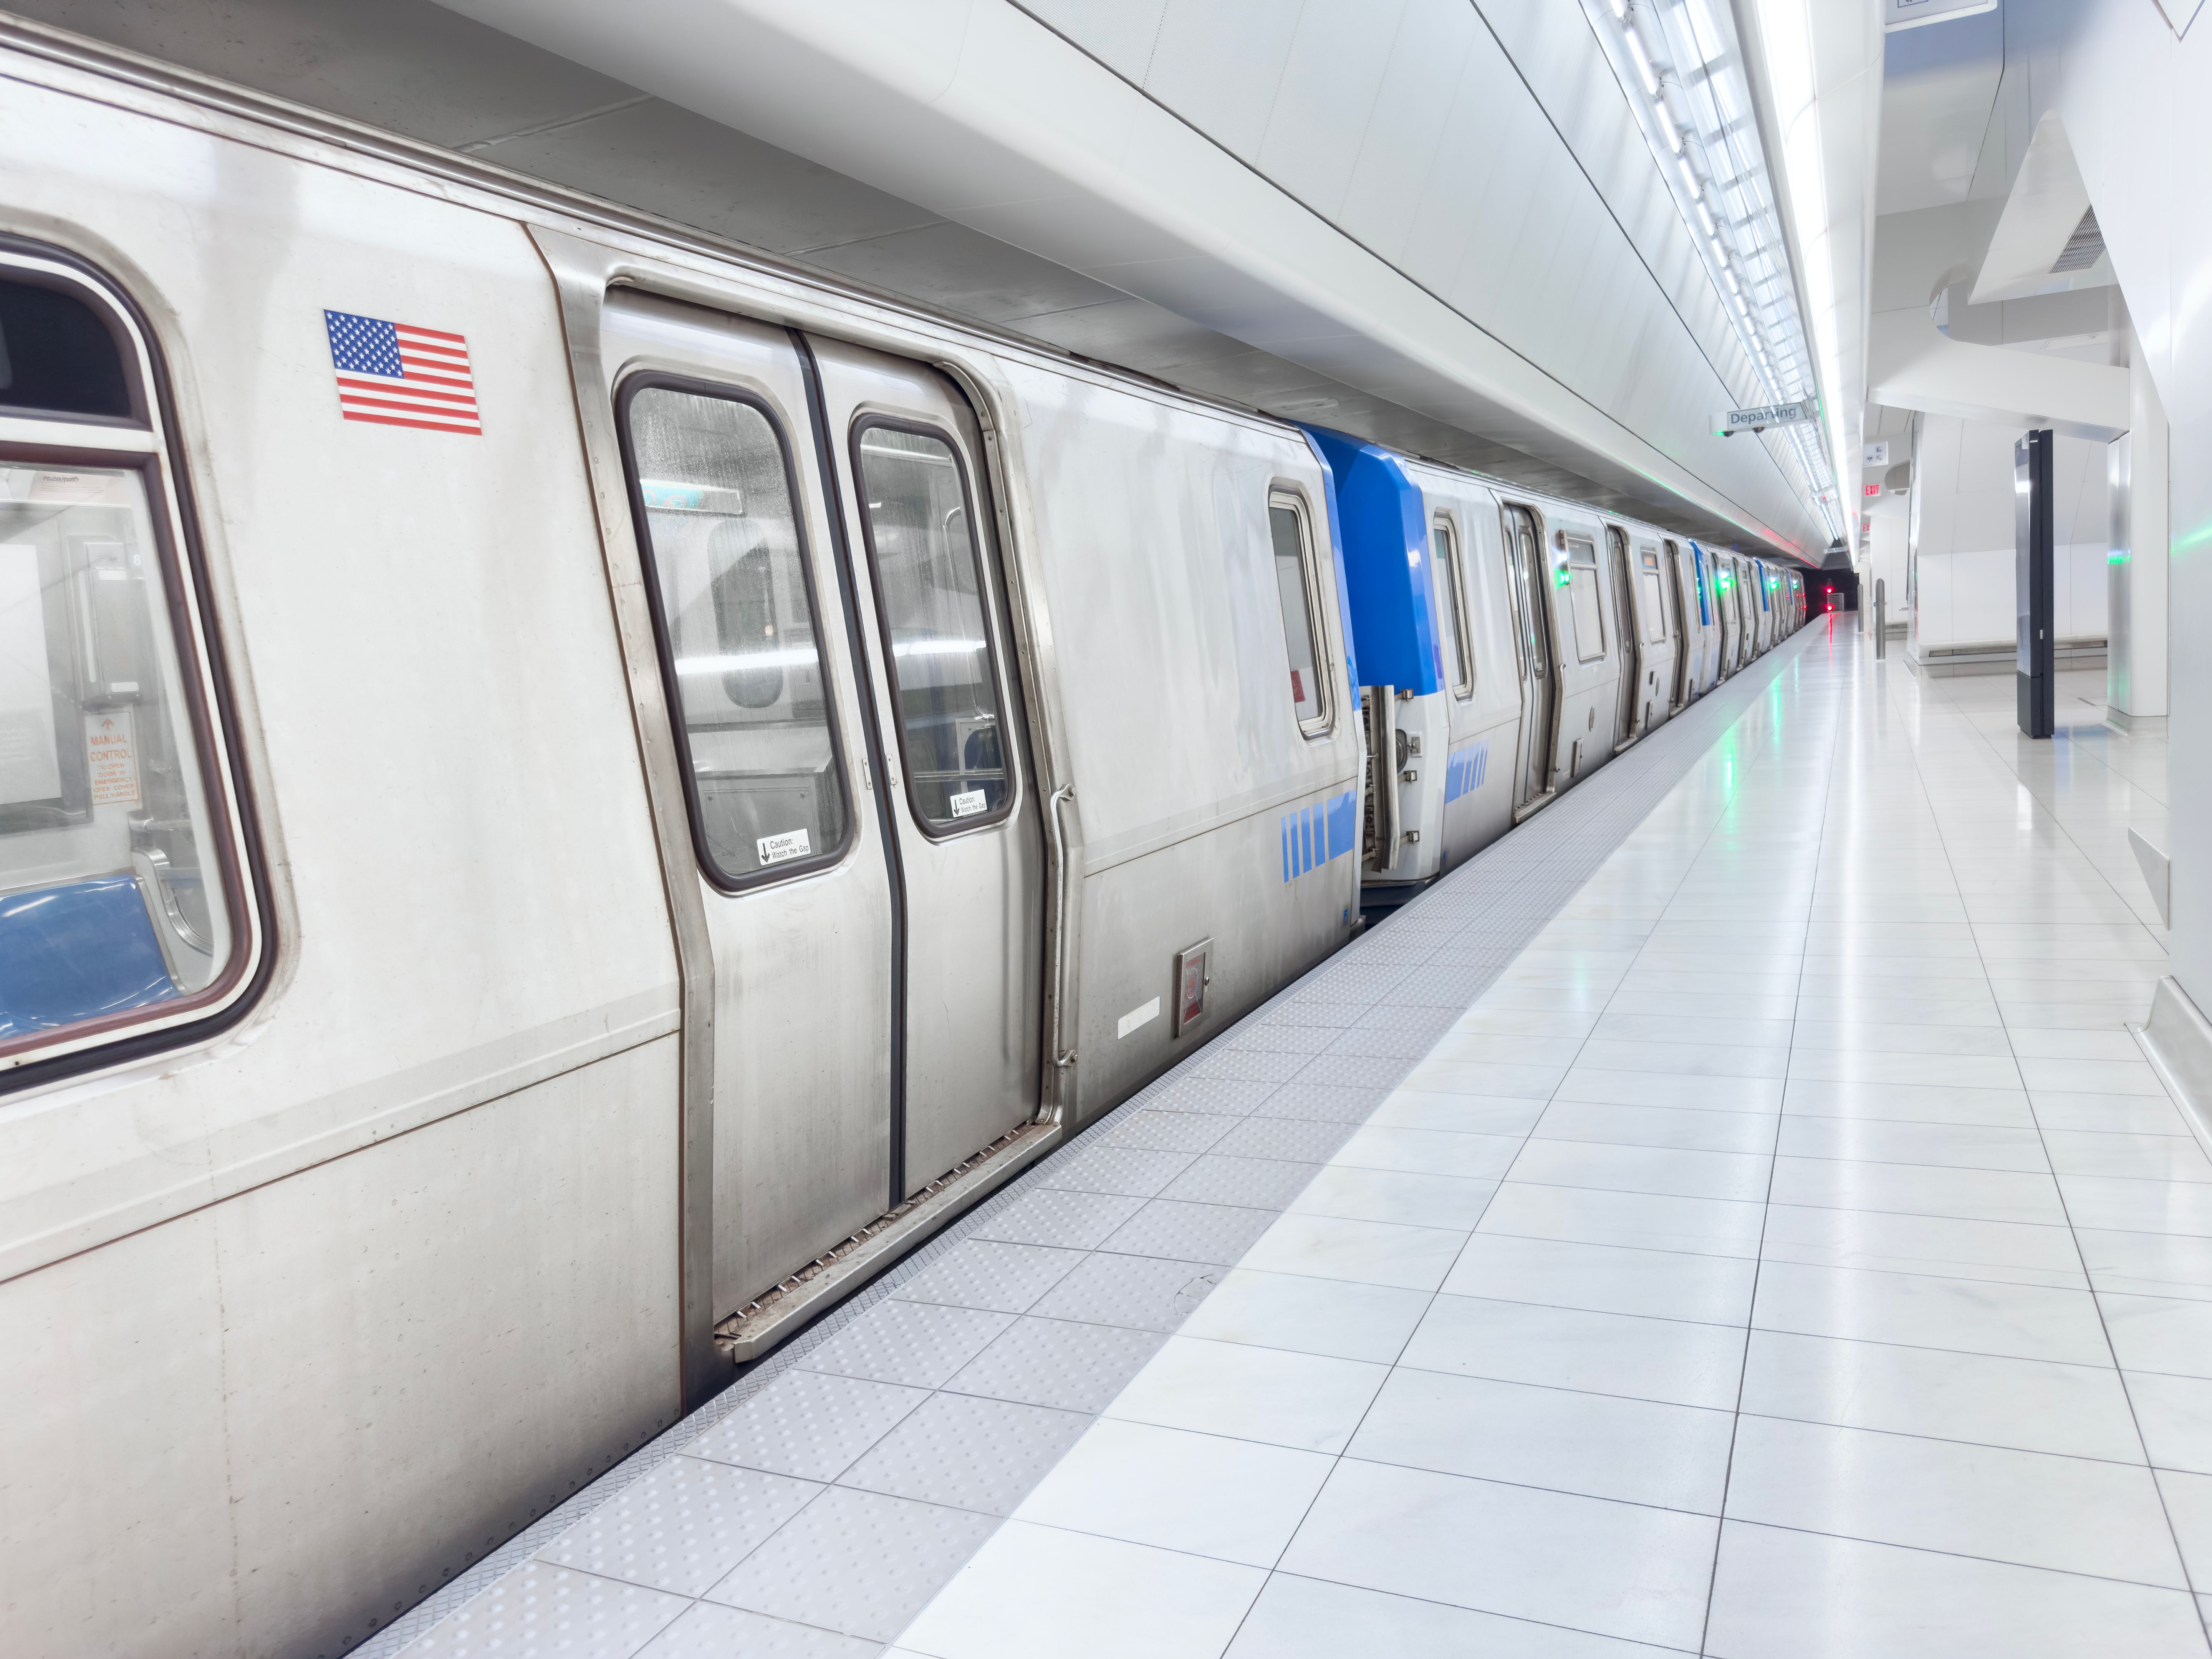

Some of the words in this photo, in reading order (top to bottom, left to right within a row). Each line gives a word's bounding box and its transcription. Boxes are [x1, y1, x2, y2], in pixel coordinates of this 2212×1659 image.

[1731, 407, 1796, 424] Departing
[1865, 484, 1879, 496] EXIT
[91, 734, 128, 746] MANUAL
[90, 749, 132, 762] CONTROL
[94, 777, 132, 785] EMERGENCY
[959, 796, 975, 805] Caution:
[770, 838, 793, 849] Caution:
[772, 849, 788, 859] Watch
[799, 845, 809, 853] Gap
